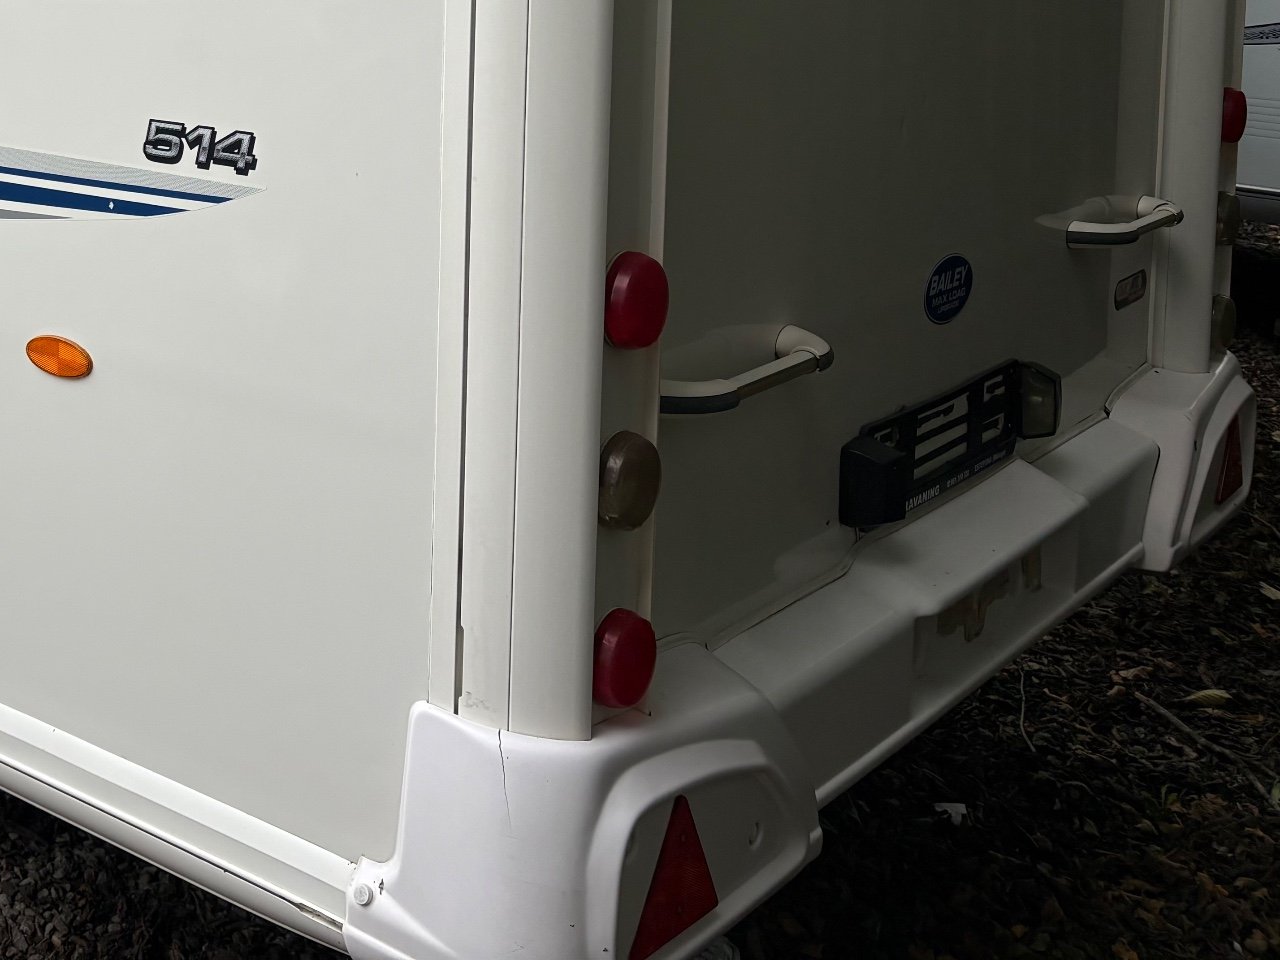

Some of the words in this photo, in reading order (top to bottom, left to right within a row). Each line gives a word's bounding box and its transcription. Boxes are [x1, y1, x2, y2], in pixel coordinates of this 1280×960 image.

[143, 118, 257, 176] 514
[929, 265, 968, 296] BAILEY
[932, 293, 948, 308] MAX
